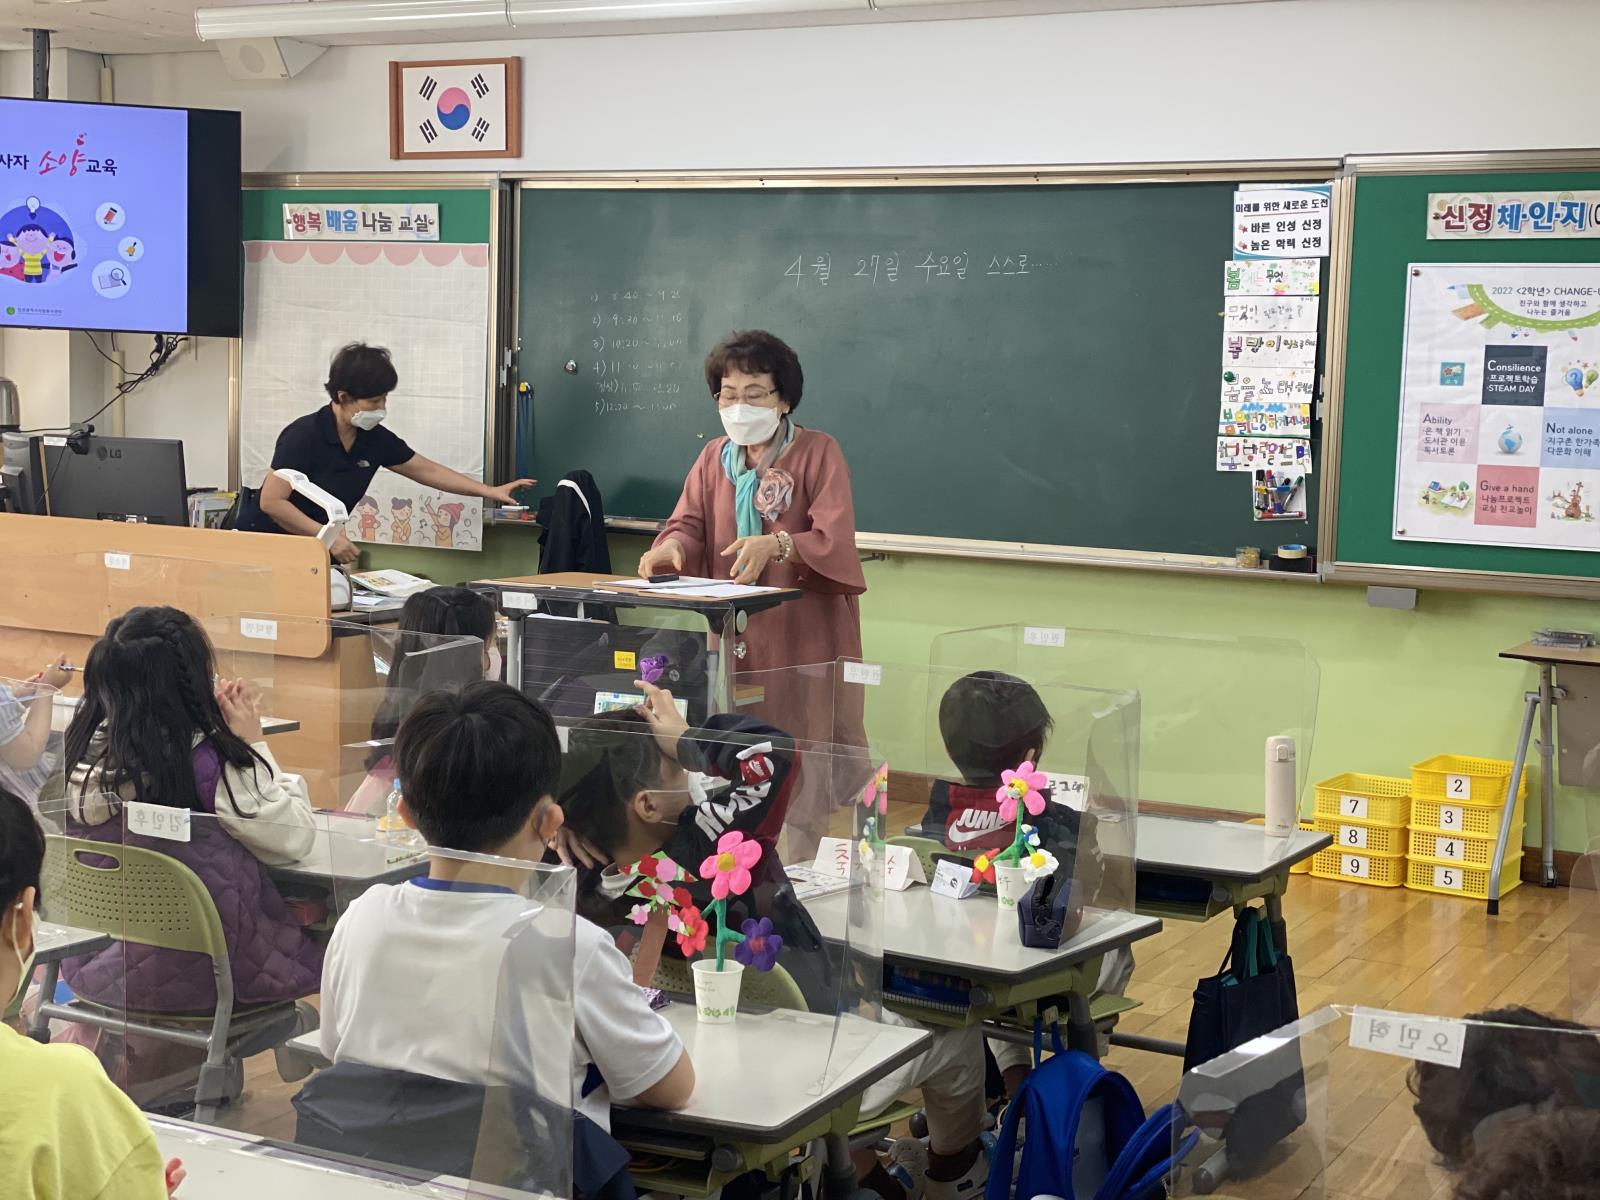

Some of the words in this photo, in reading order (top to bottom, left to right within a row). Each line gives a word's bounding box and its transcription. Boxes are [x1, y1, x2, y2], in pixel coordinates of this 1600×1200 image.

[1235, 203, 1260, 213] 미래를
[1263, 201, 1280, 212] 위한
[1282, 200, 1309, 211] 새로운
[1311, 198, 1329, 209] 도전
[292, 211, 322, 233] 행복
[326, 209, 358, 232] 배움
[362, 212, 392, 233] 나눔
[398, 214, 429, 233] 교실
[1441, 202, 1493, 231] 신정
[1251, 222, 1270, 233] 바른
[1276, 220, 1296, 232] 인성
[1302, 219, 1322, 231] 신정
[1251, 240, 1270, 251] 높은
[1276, 238, 1296, 249] 학력
[1302, 237, 1321, 248] 신정
[914, 251, 969, 284] 수요일
[1492, 286, 1513, 295] 2022
[1516, 286, 1551, 297] <2학년>
[1553, 287, 1600, 296] CHANGE-
[1519, 299, 1540, 307] 친구와
[1559, 299, 1587, 308] 생각하고
[1527, 308, 1547, 316] 나누는
[1487, 359, 1542, 373] Consilience
[1489, 374, 1539, 385] 프로젝트학습
[1488, 384, 1517, 392] STEAM
[1519, 385, 1536, 393] DAY
[1422, 412, 1453, 426] Ability
[1546, 422, 1565, 434] Not
[1567, 426, 1593, 435] alone
[1424, 436, 1448, 446] 도서관
[109, 449, 122, 459] LG
[1547, 446, 1572, 456] 다문화
[1574, 447, 1592, 457] 이해
[1480, 480, 1501, 491] Give
[1512, 484, 1535, 493] hand
[1454, 779, 1463, 793] 2
[1349, 799, 1358, 814] 7
[1444, 810, 1453, 824] 3
[1348, 829, 1358, 844] 8
[1445, 842, 1455, 856] 4
[1350, 858, 1360, 874] 9
[1443, 871, 1453, 885] 5
